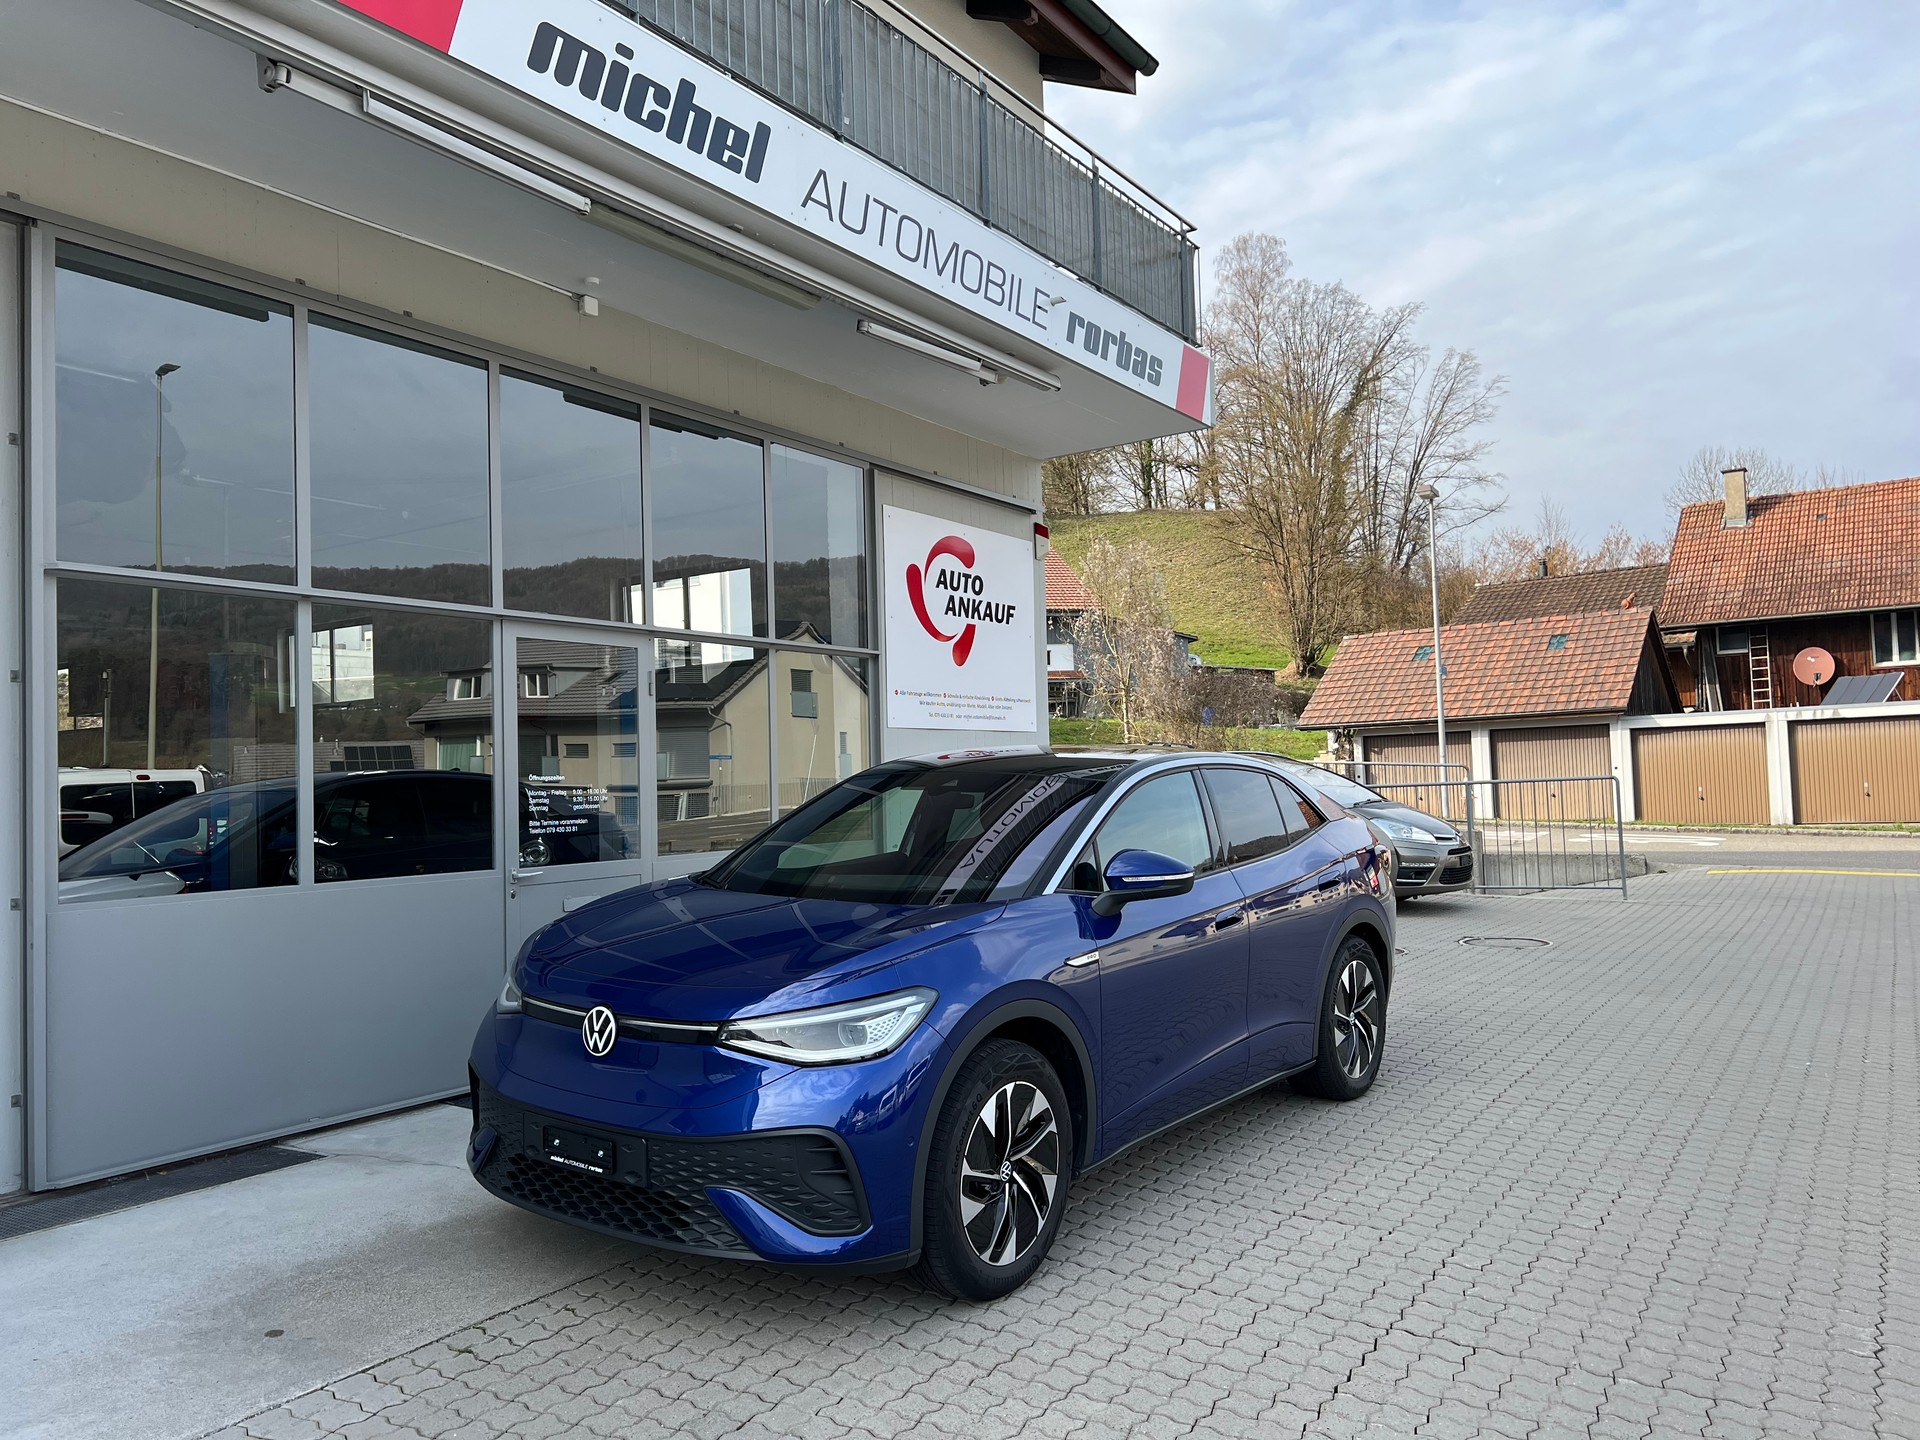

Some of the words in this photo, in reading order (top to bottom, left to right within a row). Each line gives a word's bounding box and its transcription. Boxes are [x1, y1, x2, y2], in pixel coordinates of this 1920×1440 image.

[527, 21, 772, 184] michel
[801, 168, 1051, 332] AUTOMOBILE
[1066, 310, 1164, 387] rorbas
[935, 568, 984, 596] AUTO
[944, 594, 1017, 625] ANKAUF
[528, 773, 566, 782] Öffnungszeiten
[528, 797, 550, 805] Samstag
[951, 1110, 974, 1175] EcoContact
[564, 1159, 589, 1170] AUTOMOBILE
